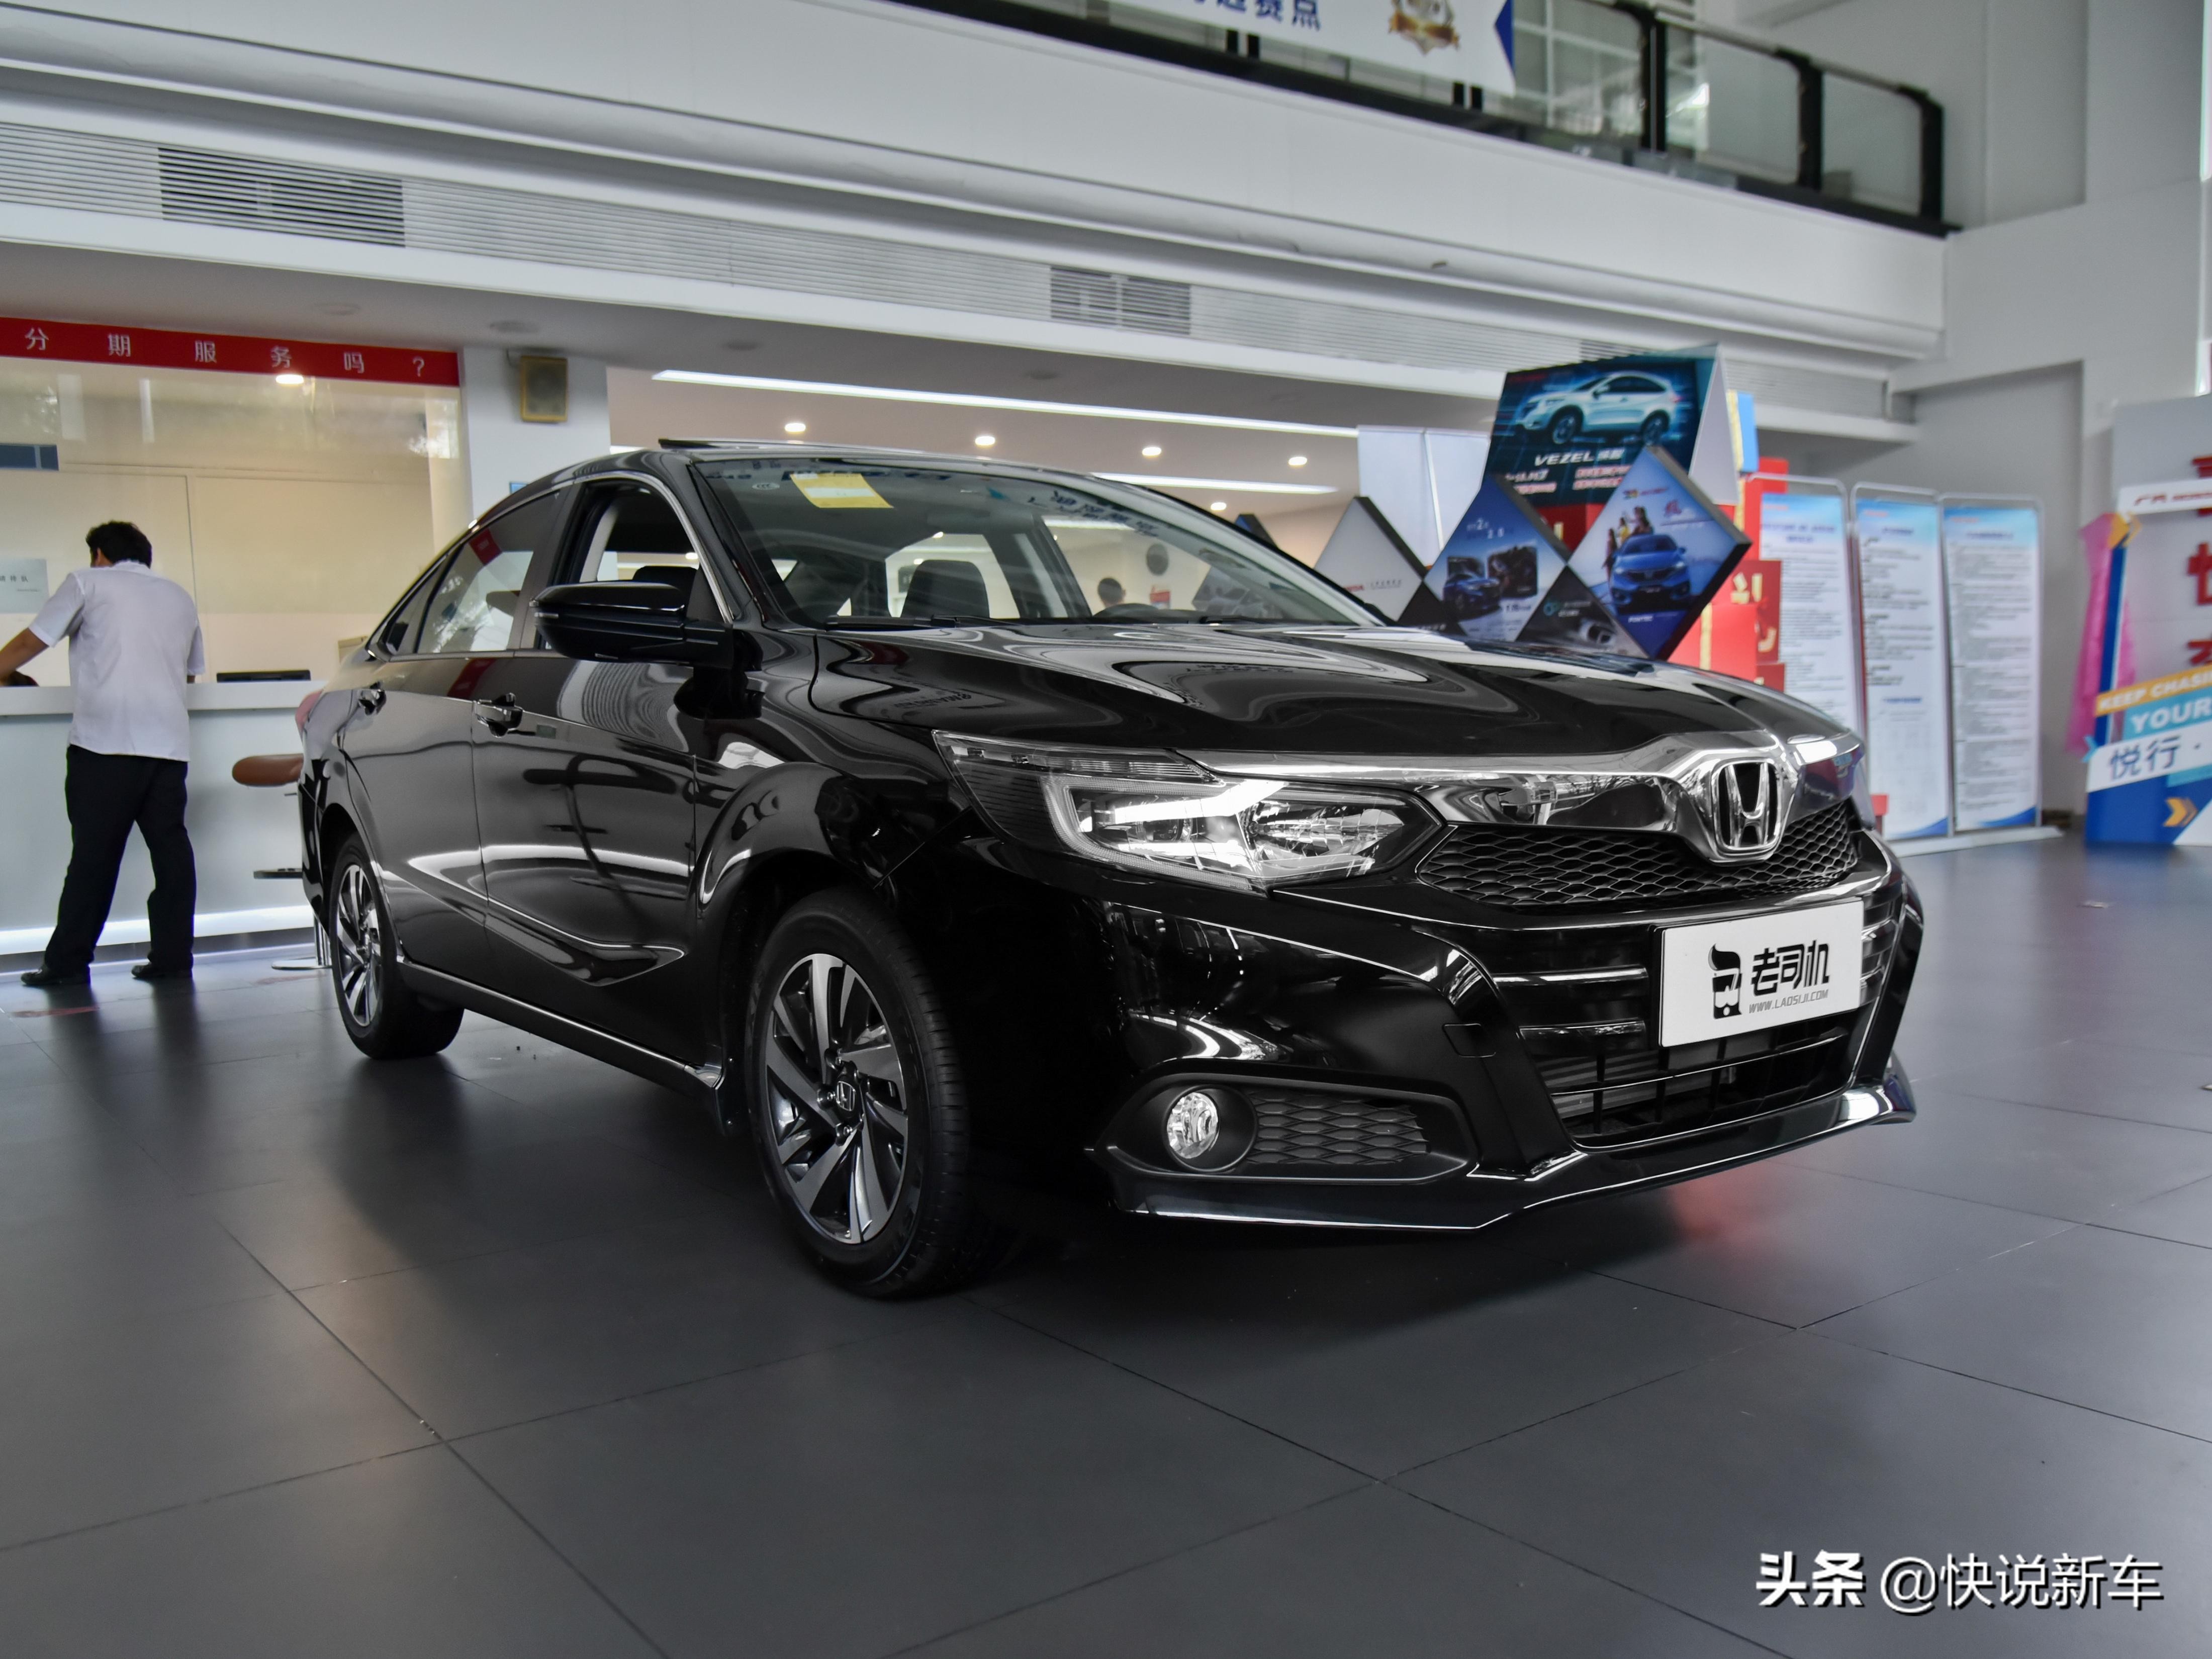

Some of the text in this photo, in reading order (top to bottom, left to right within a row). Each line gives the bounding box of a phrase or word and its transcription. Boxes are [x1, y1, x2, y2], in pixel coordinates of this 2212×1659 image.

[1535, 451, 1594, 466] VEZEL
[2100, 688, 2146, 711] KEEP
[1750, 939, 1830, 997] 老司机
[1748, 989, 1829, 1014] WWW.LAOSIJI.COM
